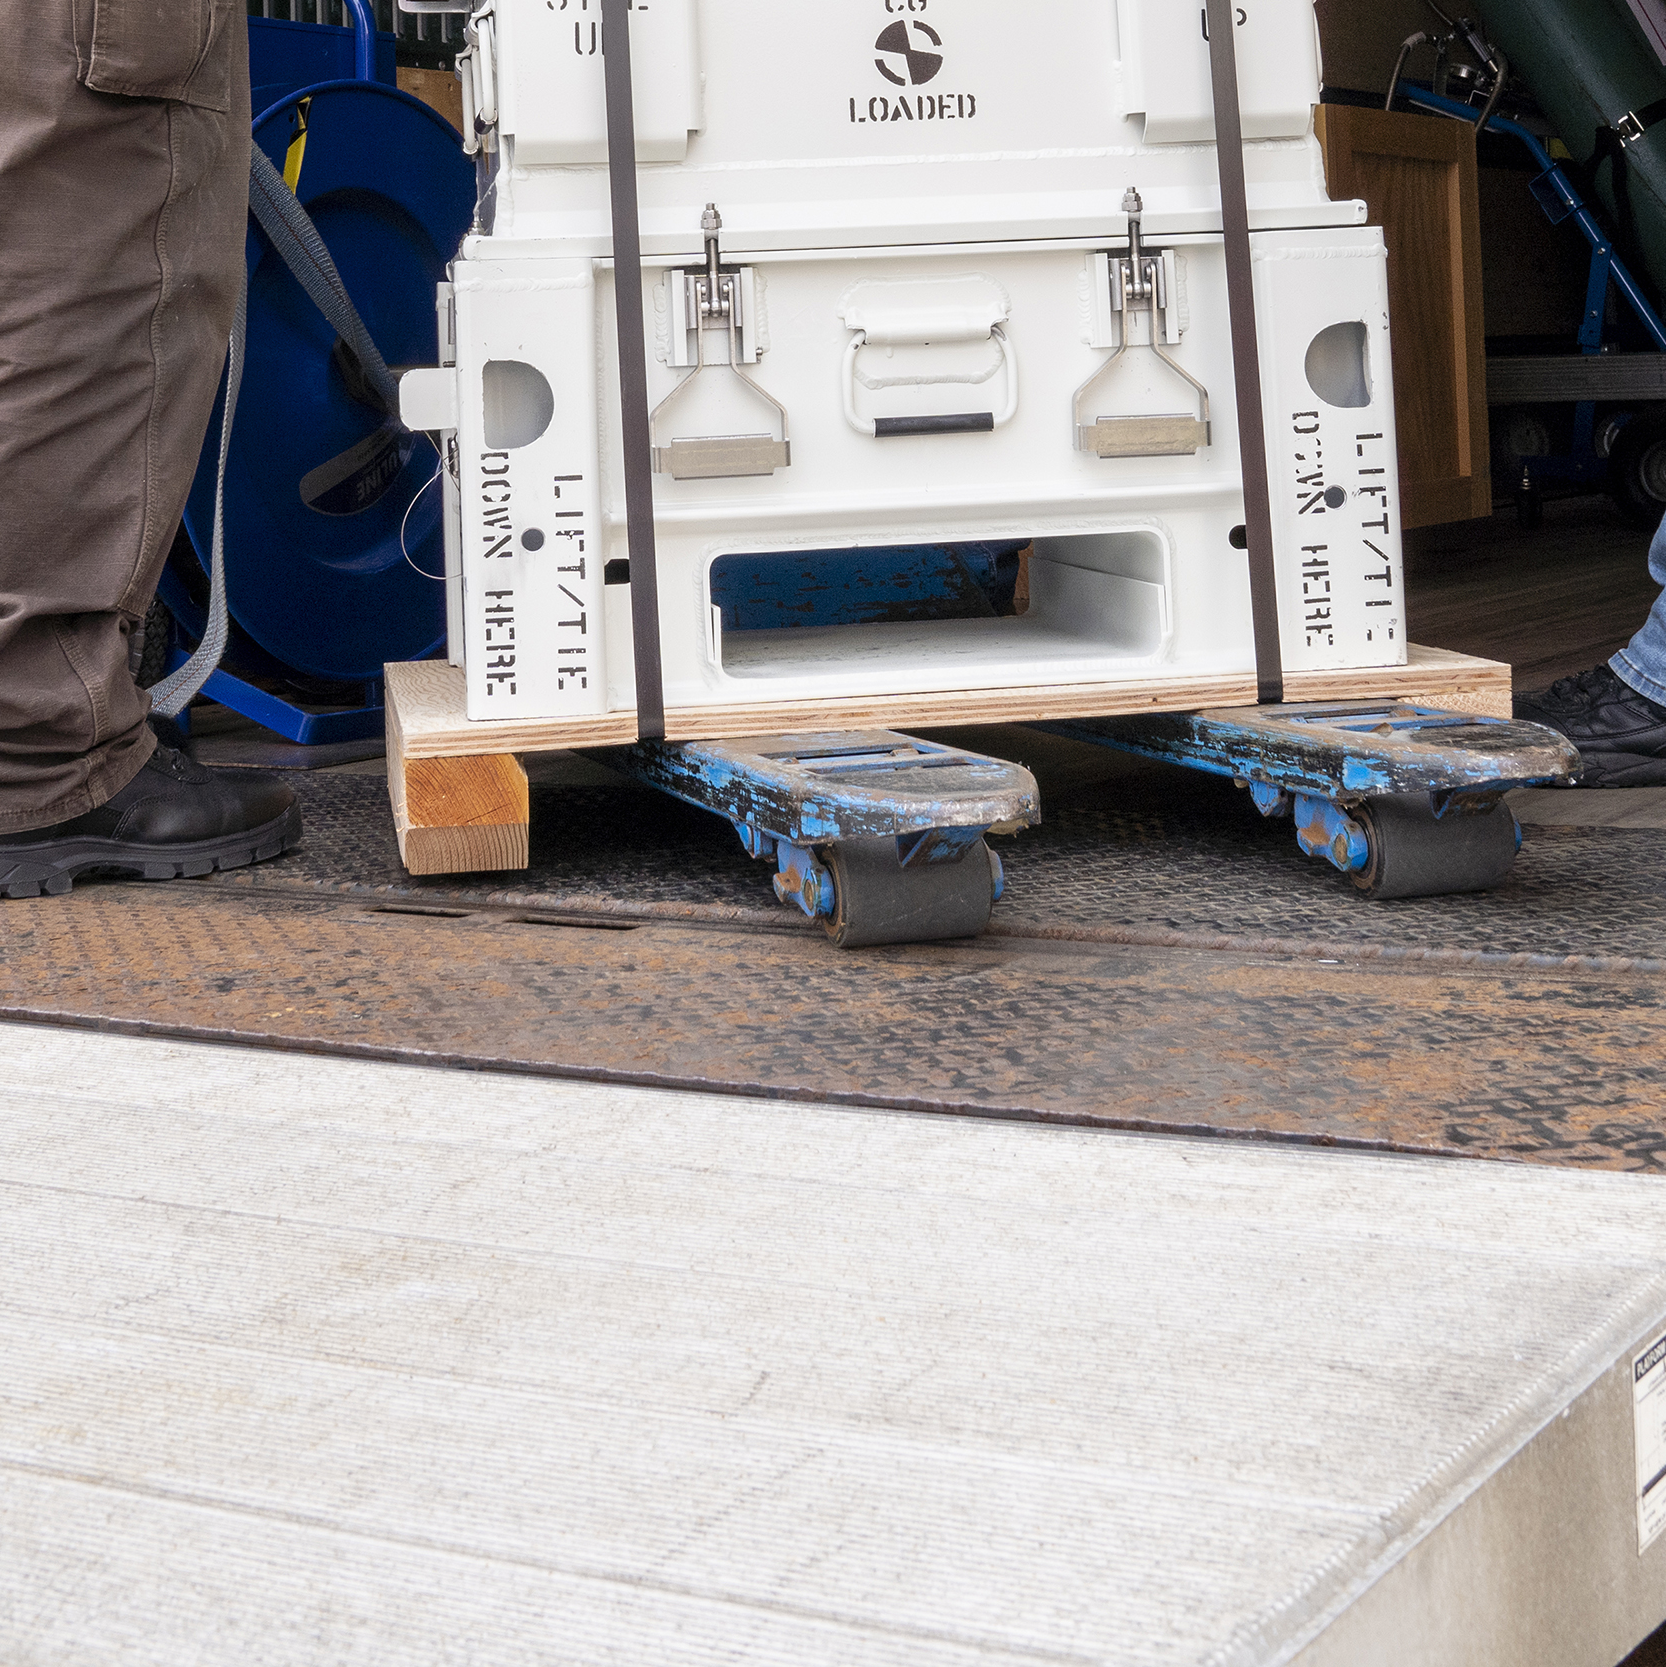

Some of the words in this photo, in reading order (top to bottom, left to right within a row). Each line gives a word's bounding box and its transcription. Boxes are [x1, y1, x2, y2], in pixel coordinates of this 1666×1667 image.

[574, 21, 604, 55] U
[849, 93, 976, 122] LOADED
[481, 452, 513, 558] DOWN
[554, 474, 587, 690] LIFT/TIE
[1301, 545, 1334, 646] HERE
[485, 590, 516, 696] HERE
